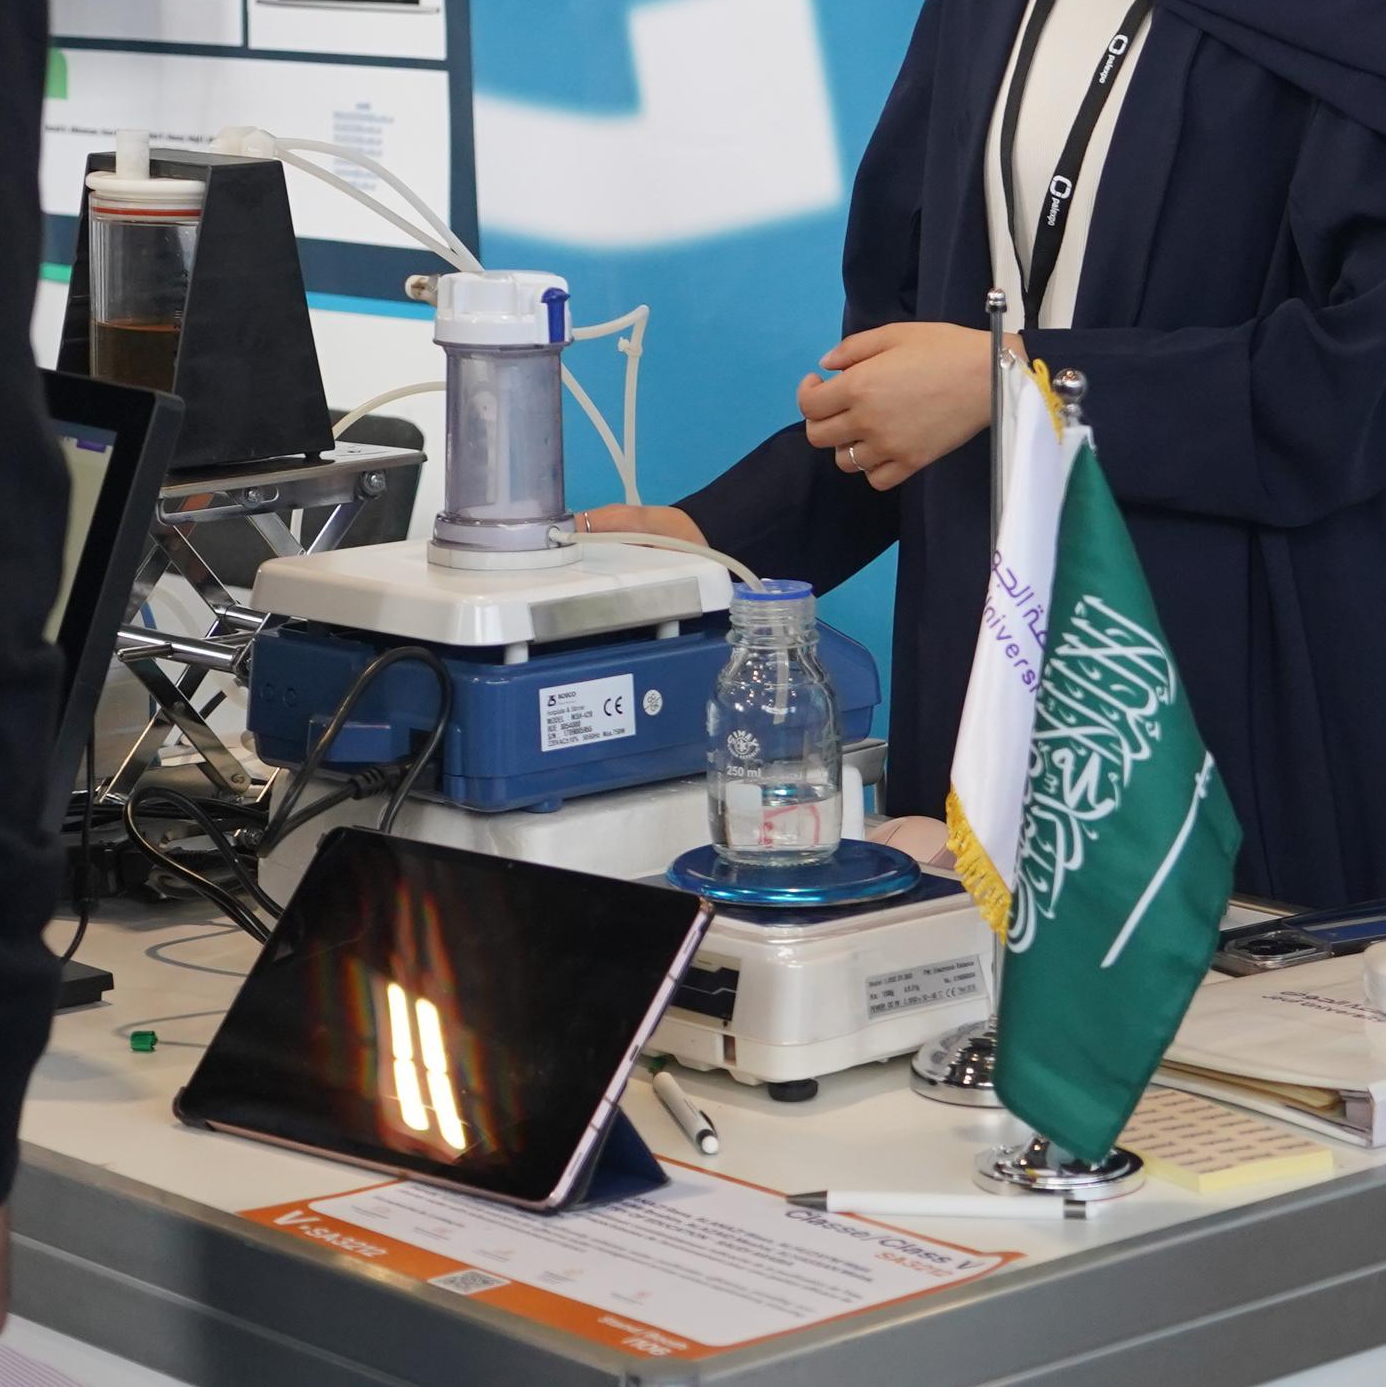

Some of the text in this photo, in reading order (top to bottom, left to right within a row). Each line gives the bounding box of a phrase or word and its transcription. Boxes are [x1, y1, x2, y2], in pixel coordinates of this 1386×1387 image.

[1099, 55, 1115, 84] palexpo
[1047, 197, 1061, 227] palexpo
[983, 599, 1043, 693] niversi
[727, 766, 761, 777] 250 ml
[273, 1210, 321, 1225] V
